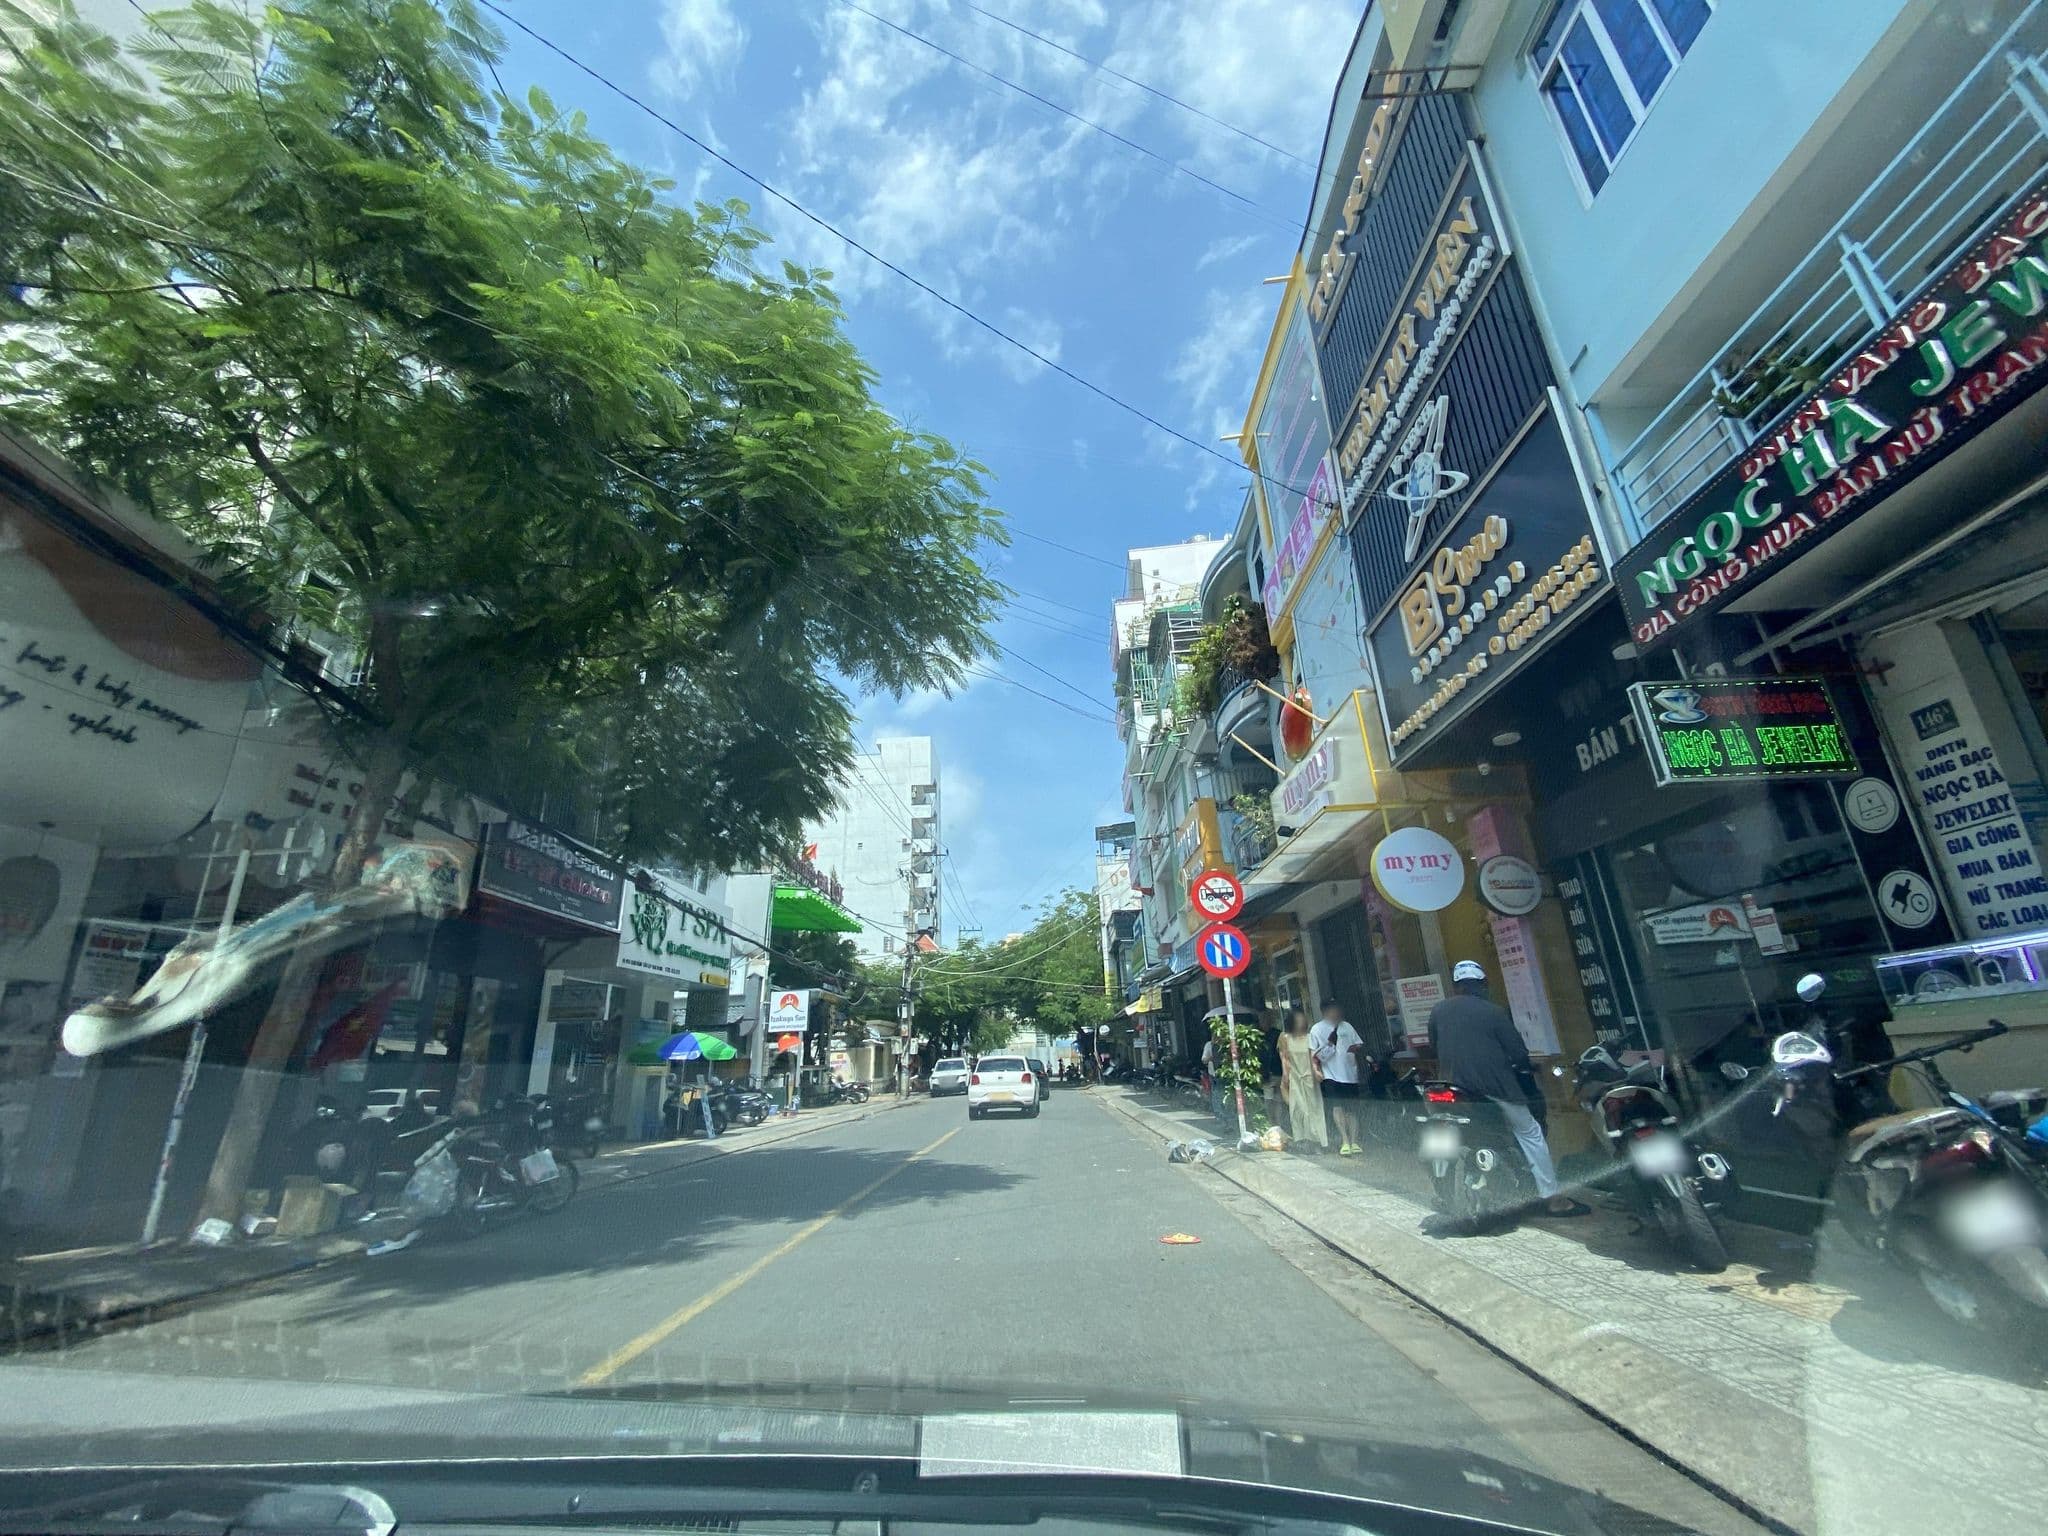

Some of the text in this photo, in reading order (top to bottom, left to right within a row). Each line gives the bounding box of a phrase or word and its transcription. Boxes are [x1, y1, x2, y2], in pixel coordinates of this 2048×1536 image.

[1635, 478, 1781, 608] NGỌC
[1780, 397, 1892, 496] HÀ
[1634, 610, 1676, 643] GIA
[1675, 558, 1747, 617] CÔNG
[1745, 511, 1816, 566] MUA
[1811, 454, 1888, 518] BÁN
[1575, 726, 1620, 773] BÁN
[1663, 729, 1723, 775] NGỌC
[1755, 724, 1845, 765] JEWELRY
[1915, 759, 1957, 781] VÀNG
[1922, 762, 2006, 806] NGỌC HÀ
[1934, 793, 2013, 831] JEWELRY
[1946, 823, 2021, 855] GIA CÔNG
[1383, 853, 1453, 873] mymy
[1956, 848, 2032, 880] MUA BÁN
[1993, 876, 2048, 900] TRANG
[1976, 908, 2009, 931] CÁC
